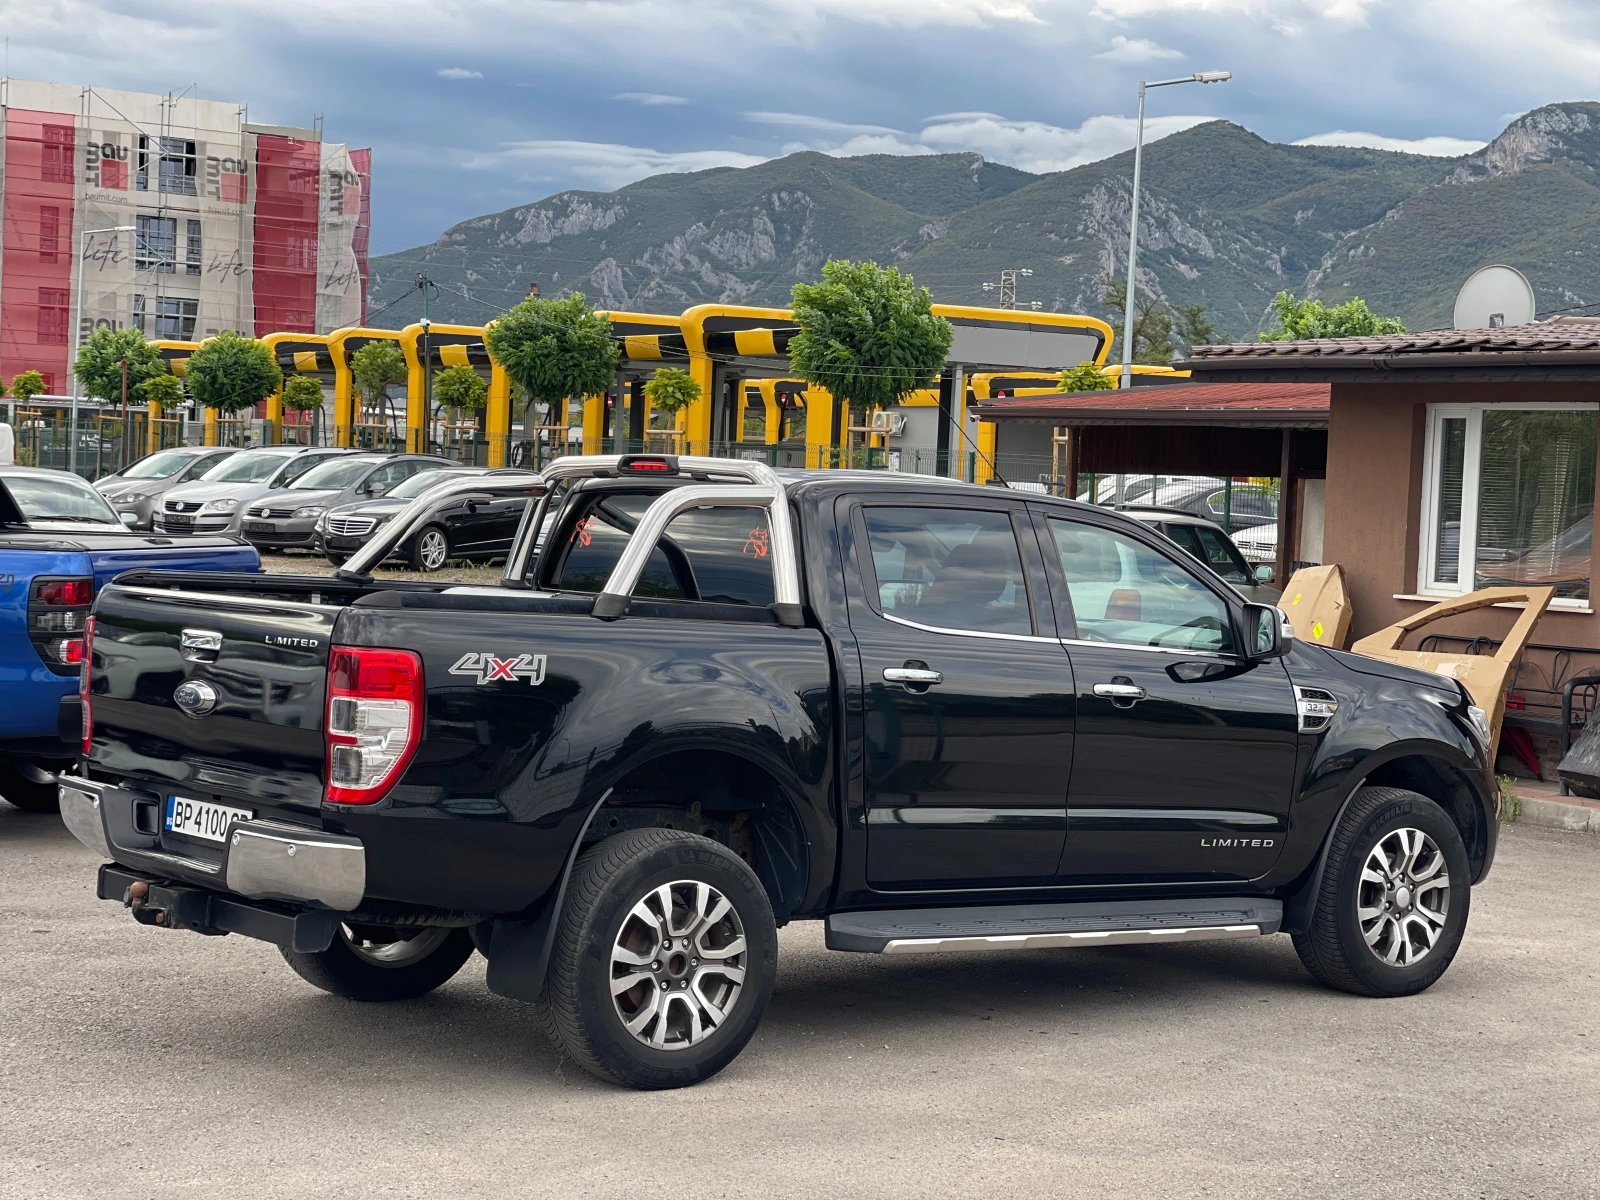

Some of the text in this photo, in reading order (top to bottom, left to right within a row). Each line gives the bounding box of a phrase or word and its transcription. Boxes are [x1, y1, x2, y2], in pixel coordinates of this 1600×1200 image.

[85, 193, 128, 204] baumit.com
[265, 635, 319, 648] LIMITED
[448, 652, 548, 686] 4x4
[177, 688, 196, 704] Ford
[1200, 838, 1274, 848] LIMITED
